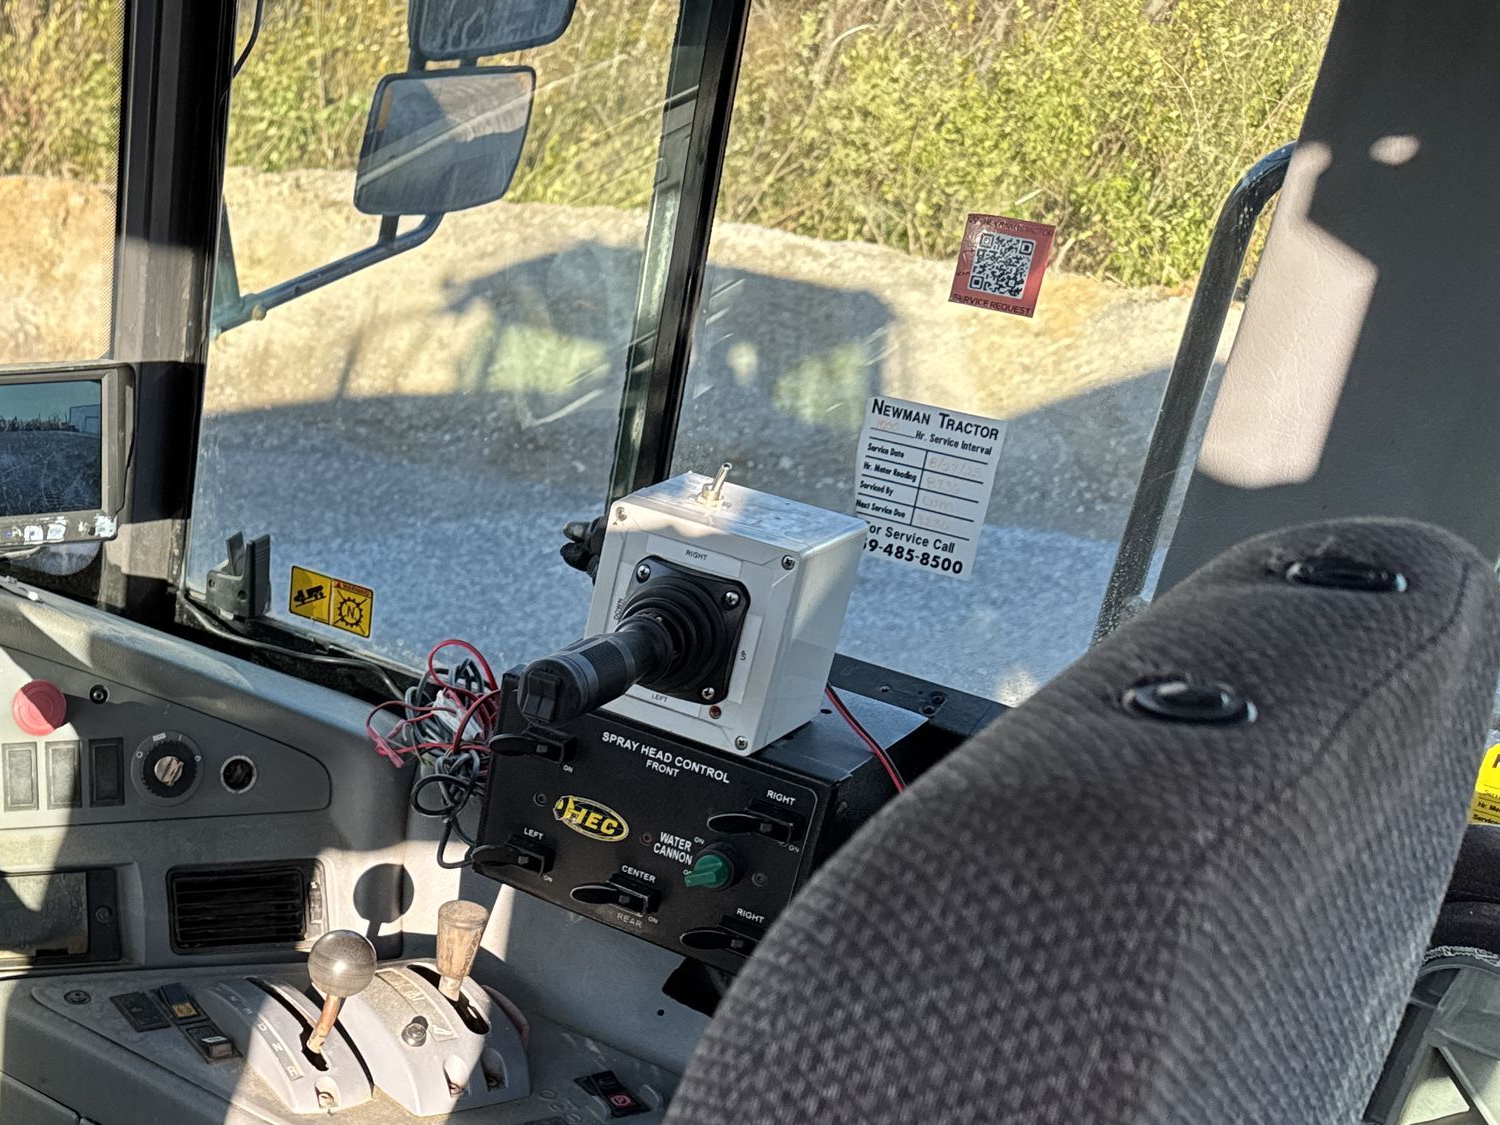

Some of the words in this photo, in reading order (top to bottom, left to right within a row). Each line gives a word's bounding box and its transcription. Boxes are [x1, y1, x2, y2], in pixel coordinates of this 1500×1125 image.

[952, 293, 989, 307] SERVICE
[990, 298, 1031, 315] REQUEST
[872, 398, 930, 425] NEWMAN
[939, 412, 999, 440] TRACTOR
[867, 443, 889, 456] Service
[890, 447, 905, 458] Date
[929, 433, 958, 448] Service
[960, 440, 993, 456] Interval
[874, 464, 892, 476] Meter
[893, 468, 917, 482] Reading
[860, 480, 885, 495] Serviced
[855, 499, 870, 510] Next
[871, 502, 893, 515] Service
[894, 509, 906, 519] Due
[866, 520, 882, 534] or
[885, 526, 930, 547] Service
[933, 538, 956, 554] Call
[685, 549, 708, 561] RIGHT
[347, 605, 355, 618] N
[613, 598, 623, 621] DOWN
[739, 650, 747, 661] UP
[651, 692, 669, 703] LEFT
[602, 731, 640, 752] SPRAY
[640, 743, 673, 763] HEAD
[674, 756, 730, 784] CONTROL
[563, 764, 574, 773] ON
[645, 759, 680, 778] FRONT
[766, 789, 797, 806] RIGHT
[565, 803, 619, 836] HEC
[523, 827, 544, 840] LEFT
[660, 831, 693, 852] WATER
[694, 836, 705, 845] ON
[653, 843, 693, 865] CANNON
[788, 844, 799, 853] ON
[543, 875, 553, 883] ON
[621, 865, 656, 883] CENTER
[616, 913, 643, 928] REAR
[647, 916, 658, 925] ON
[736, 907, 765, 924] RIGHT
[257, 1023, 268, 1033] D
[273, 1043, 284, 1053] N
[286, 1065, 298, 1077] R
